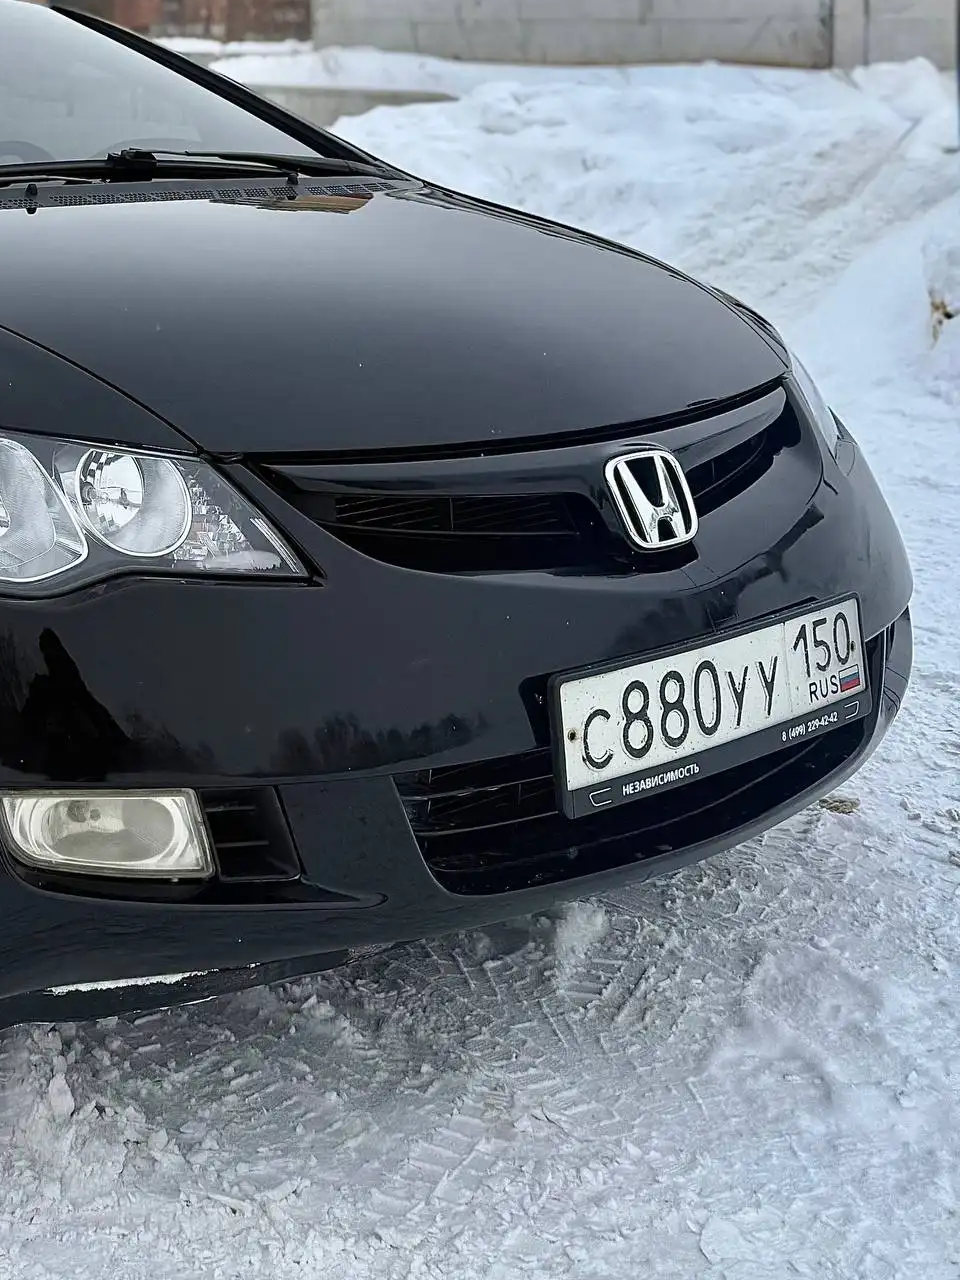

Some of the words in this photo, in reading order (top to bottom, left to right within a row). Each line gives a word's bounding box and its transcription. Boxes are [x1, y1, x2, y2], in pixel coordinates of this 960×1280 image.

[793, 611, 851, 678] 150
[809, 675, 839, 703] RUS
[781, 731, 787, 741] 8
[788, 724, 806, 739] (499)
[807, 712, 838, 732] 229-42-42
[622, 763, 700, 796] НЕЗАВИСИМОСТЬ
